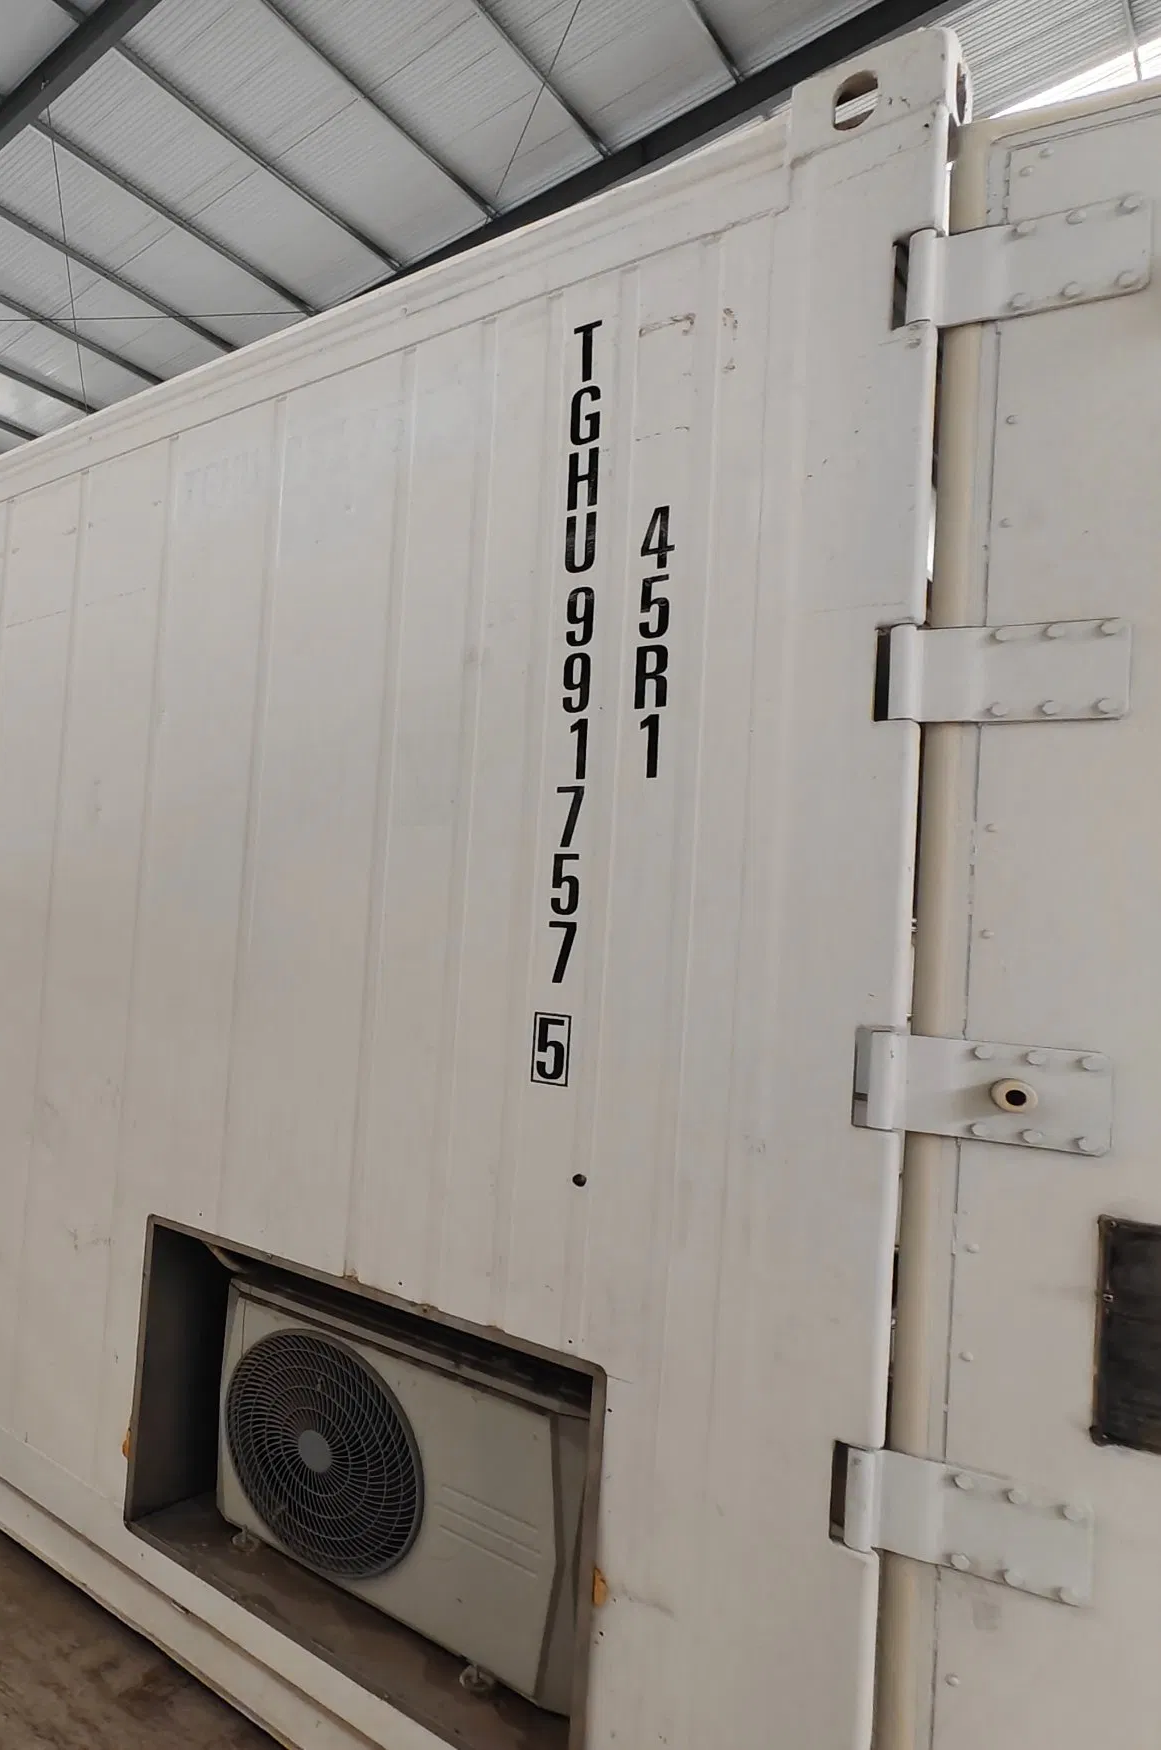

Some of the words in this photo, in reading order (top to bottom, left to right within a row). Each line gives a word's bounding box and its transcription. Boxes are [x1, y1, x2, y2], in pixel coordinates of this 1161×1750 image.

[564, 319, 603, 573] TGHU
[634, 505, 675, 778] 45R1
[549, 586, 595, 983] 991757
[535, 1016, 566, 1081] 5
